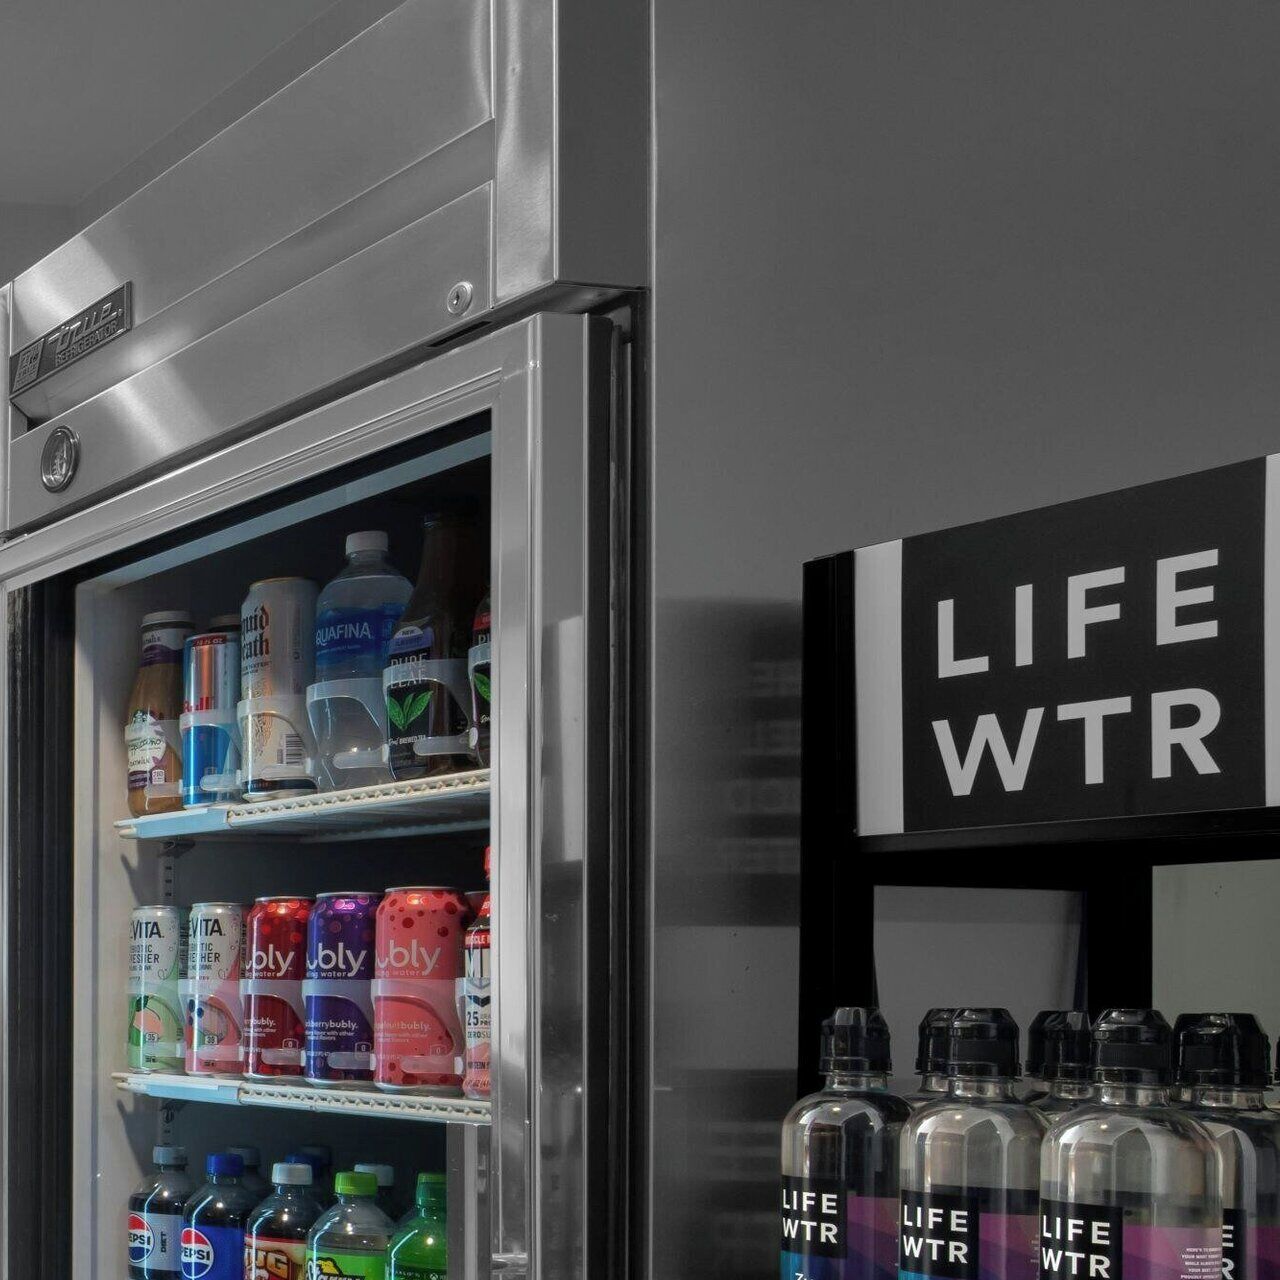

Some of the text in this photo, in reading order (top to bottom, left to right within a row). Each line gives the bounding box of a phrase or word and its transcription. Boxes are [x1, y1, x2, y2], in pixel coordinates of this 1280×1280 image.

[938, 548, 1219, 679] LIFE
[240, 630, 271, 661] eath
[316, 621, 371, 647] QUAFINA
[931, 687, 1222, 797] WTR
[245, 943, 295, 977] bly
[306, 942, 368, 978] ubly
[375, 938, 441, 977] ubly
[320, 970, 348, 978] water
[467, 1011, 479, 1026] 25
[782, 1188, 839, 1215] LIFE
[782, 1216, 839, 1245] WTR
[902, 1203, 969, 1234] LIFE
[1042, 1214, 1111, 1246] LIFE
[127, 1232, 152, 1247] EPSI
[160, 1230, 168, 1253] DIET
[181, 1246, 211, 1262] PEPSI
[902, 1235, 969, 1265] WTR
[245, 1247, 290, 1280] UG
[1042, 1246, 1111, 1280] WTR
